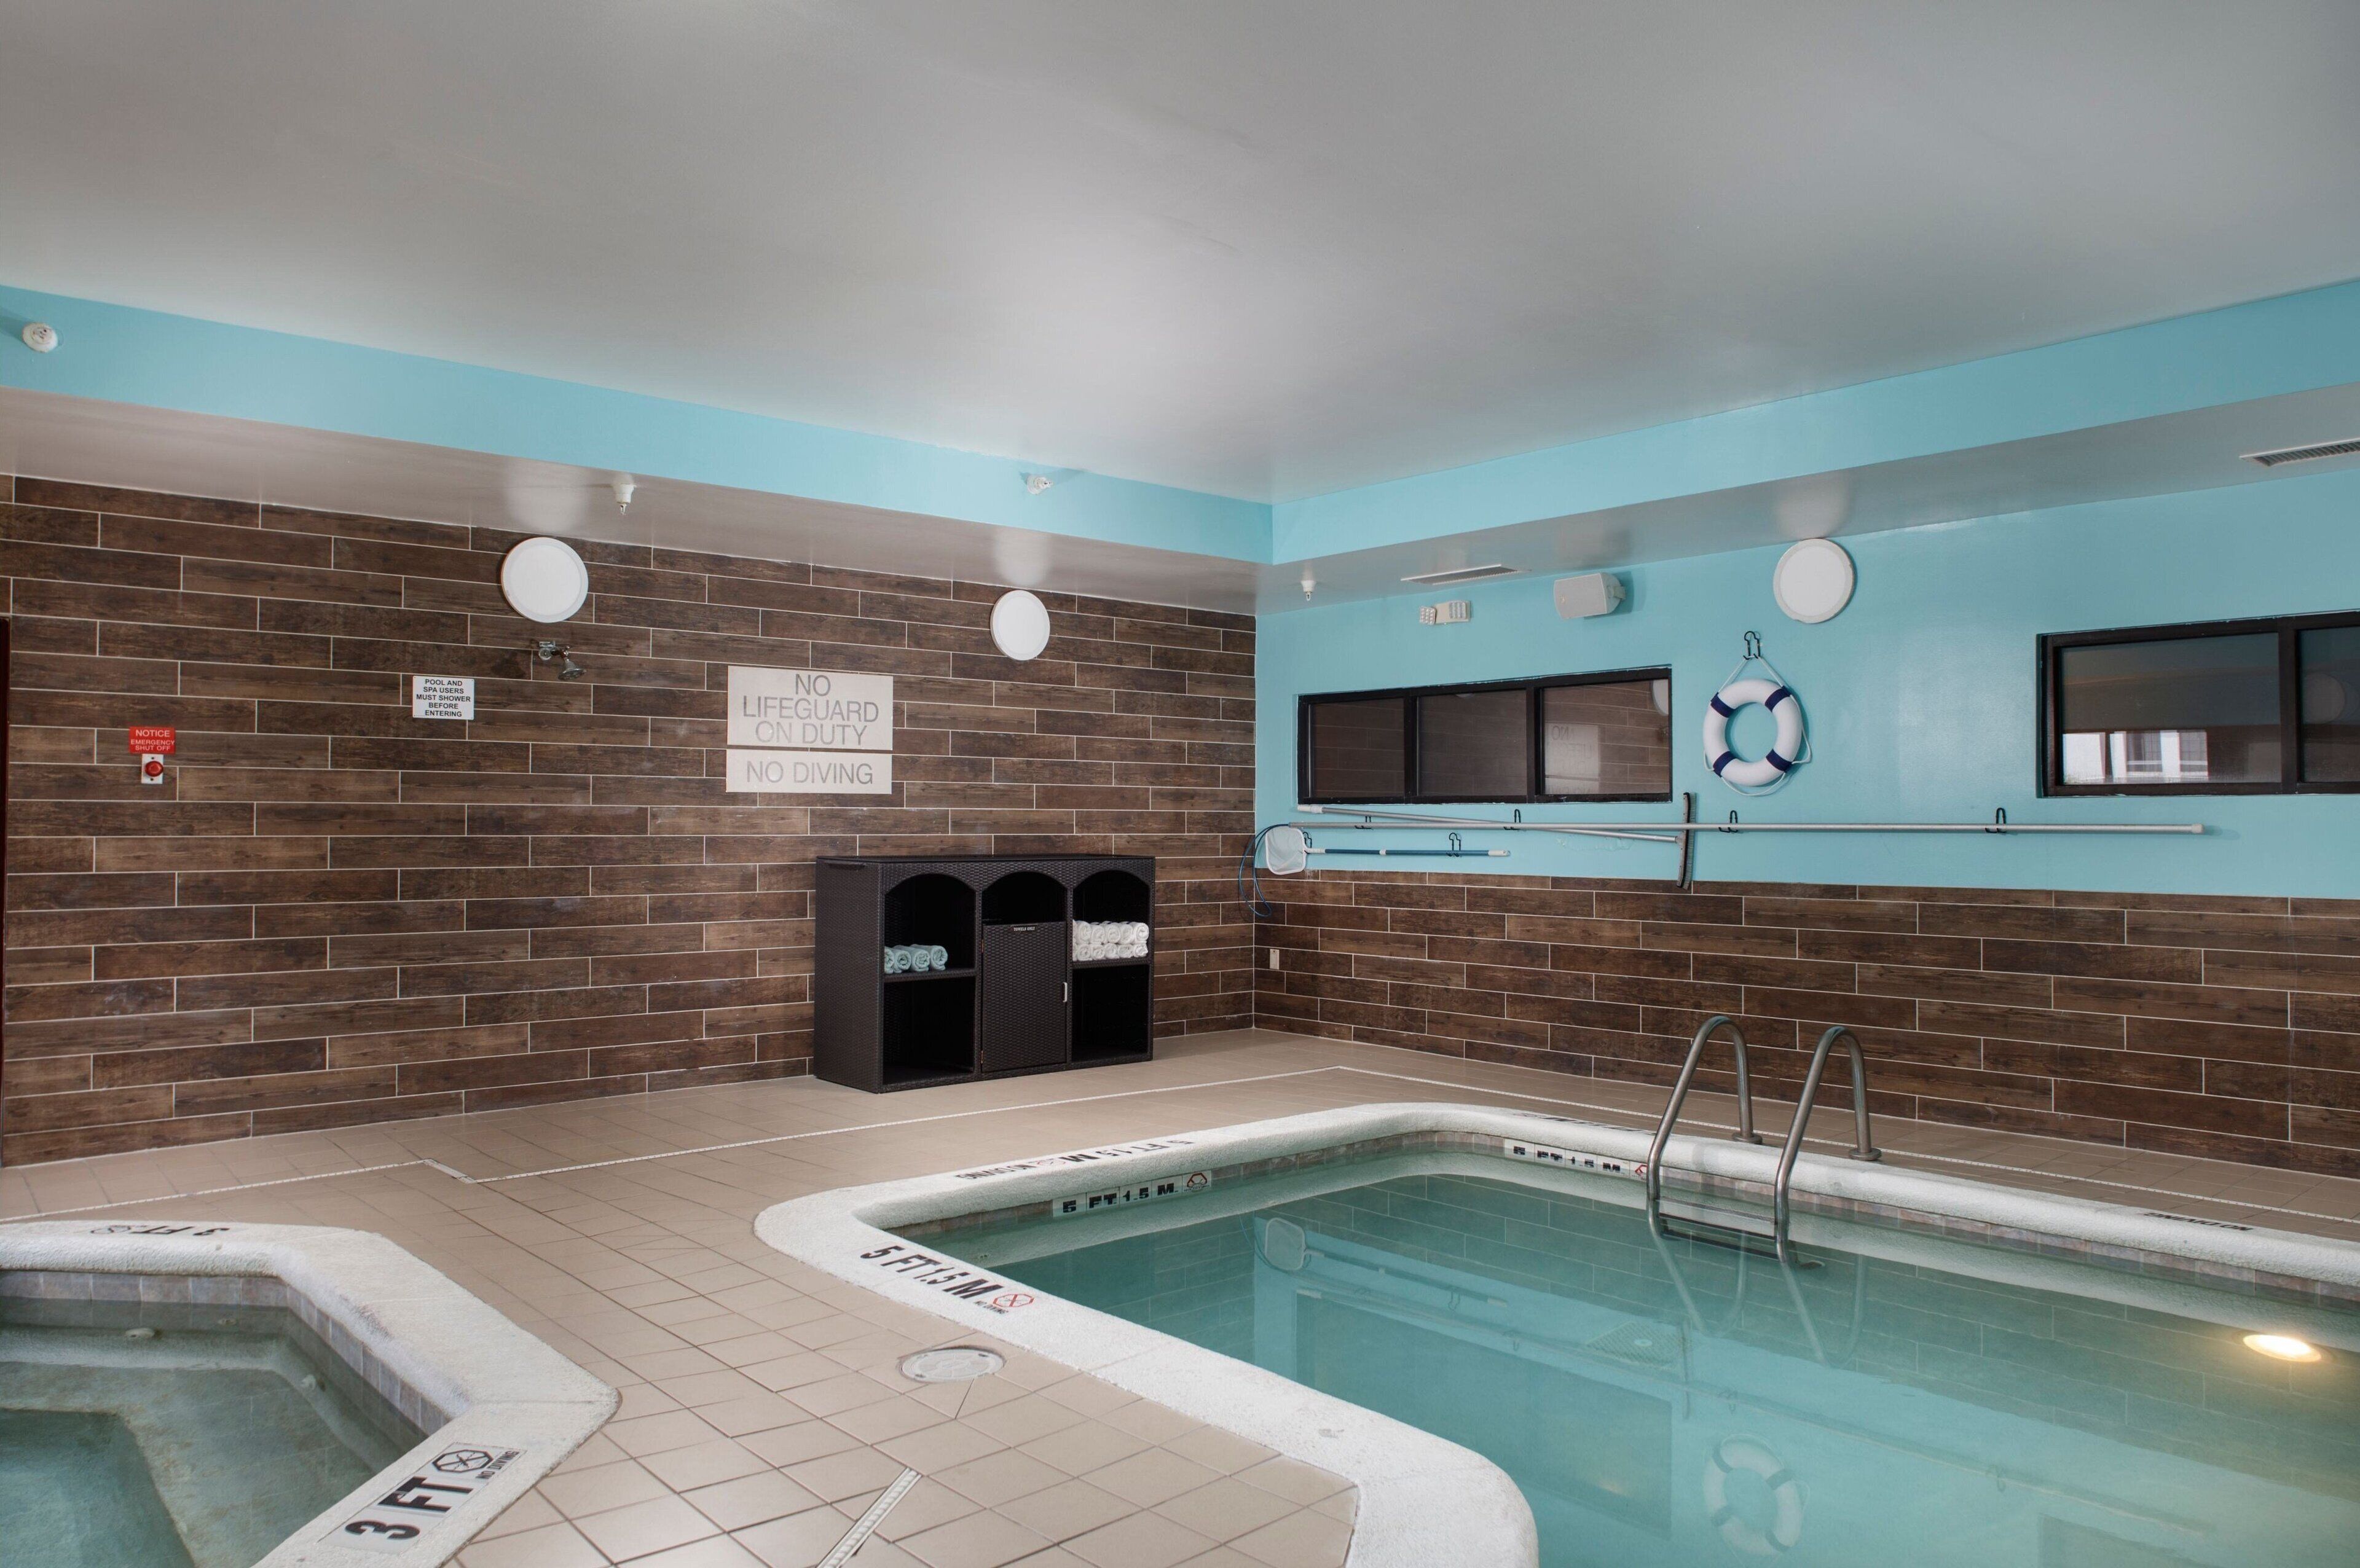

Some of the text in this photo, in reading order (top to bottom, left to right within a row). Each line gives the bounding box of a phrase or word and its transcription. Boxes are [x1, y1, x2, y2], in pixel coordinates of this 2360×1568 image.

[795, 673, 831, 696] NO
[742, 695, 879, 723] LIFEGUARD
[755, 720, 868, 746] ON DUTY
[746, 761, 873, 785] NO DIVING
[1058, 1154, 1101, 1162] M
[1063, 1200, 1077, 1213] 5
[860, 1245, 905, 1259] 5
[881, 1254, 942, 1272] FT
[942, 1279, 1004, 1299] M
[476, 1451, 520, 1479] NO DIVING
[344, 1475, 473, 1540] 3 FT
